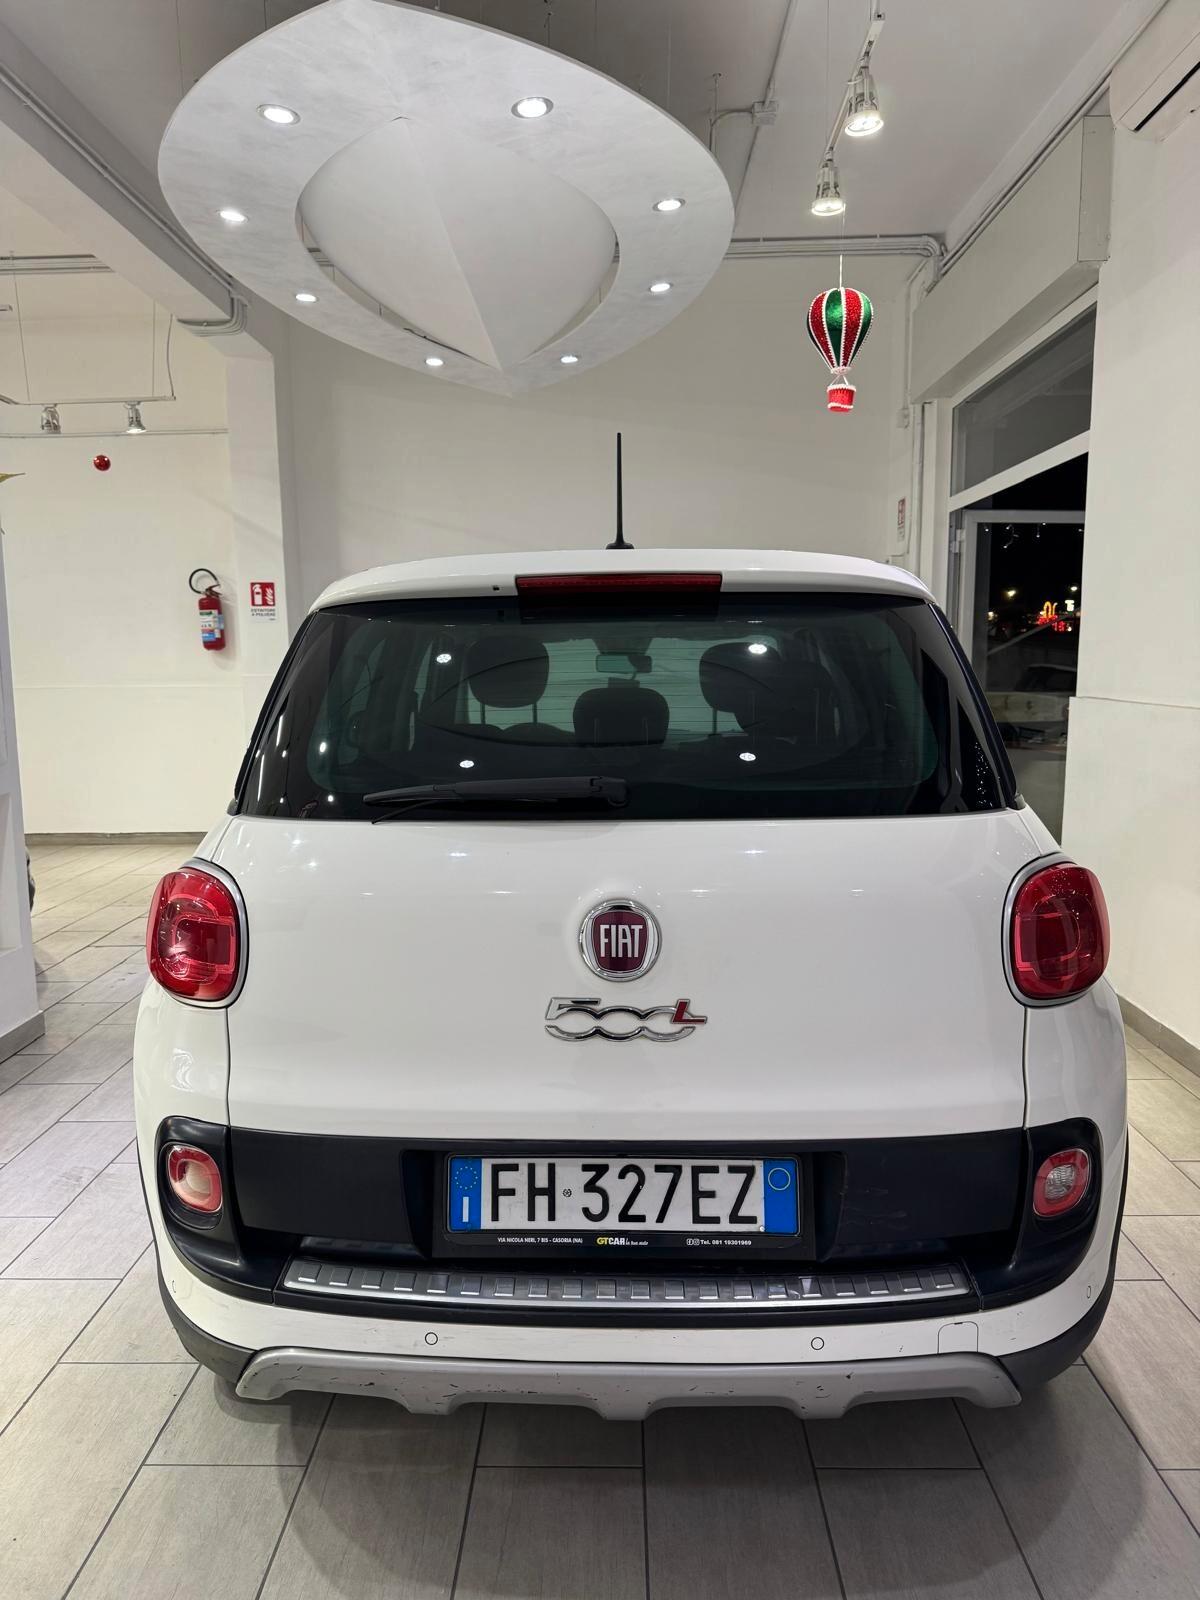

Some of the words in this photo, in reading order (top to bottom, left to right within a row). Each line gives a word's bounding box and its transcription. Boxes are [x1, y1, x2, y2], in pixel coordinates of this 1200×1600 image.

[599, 924, 643, 958] FIAT
[545, 997, 708, 1042] 500L
[491, 1162, 556, 1222] FH
[581, 1163, 758, 1224] 327EZ
[596, 1236, 626, 1246] GTCAR
